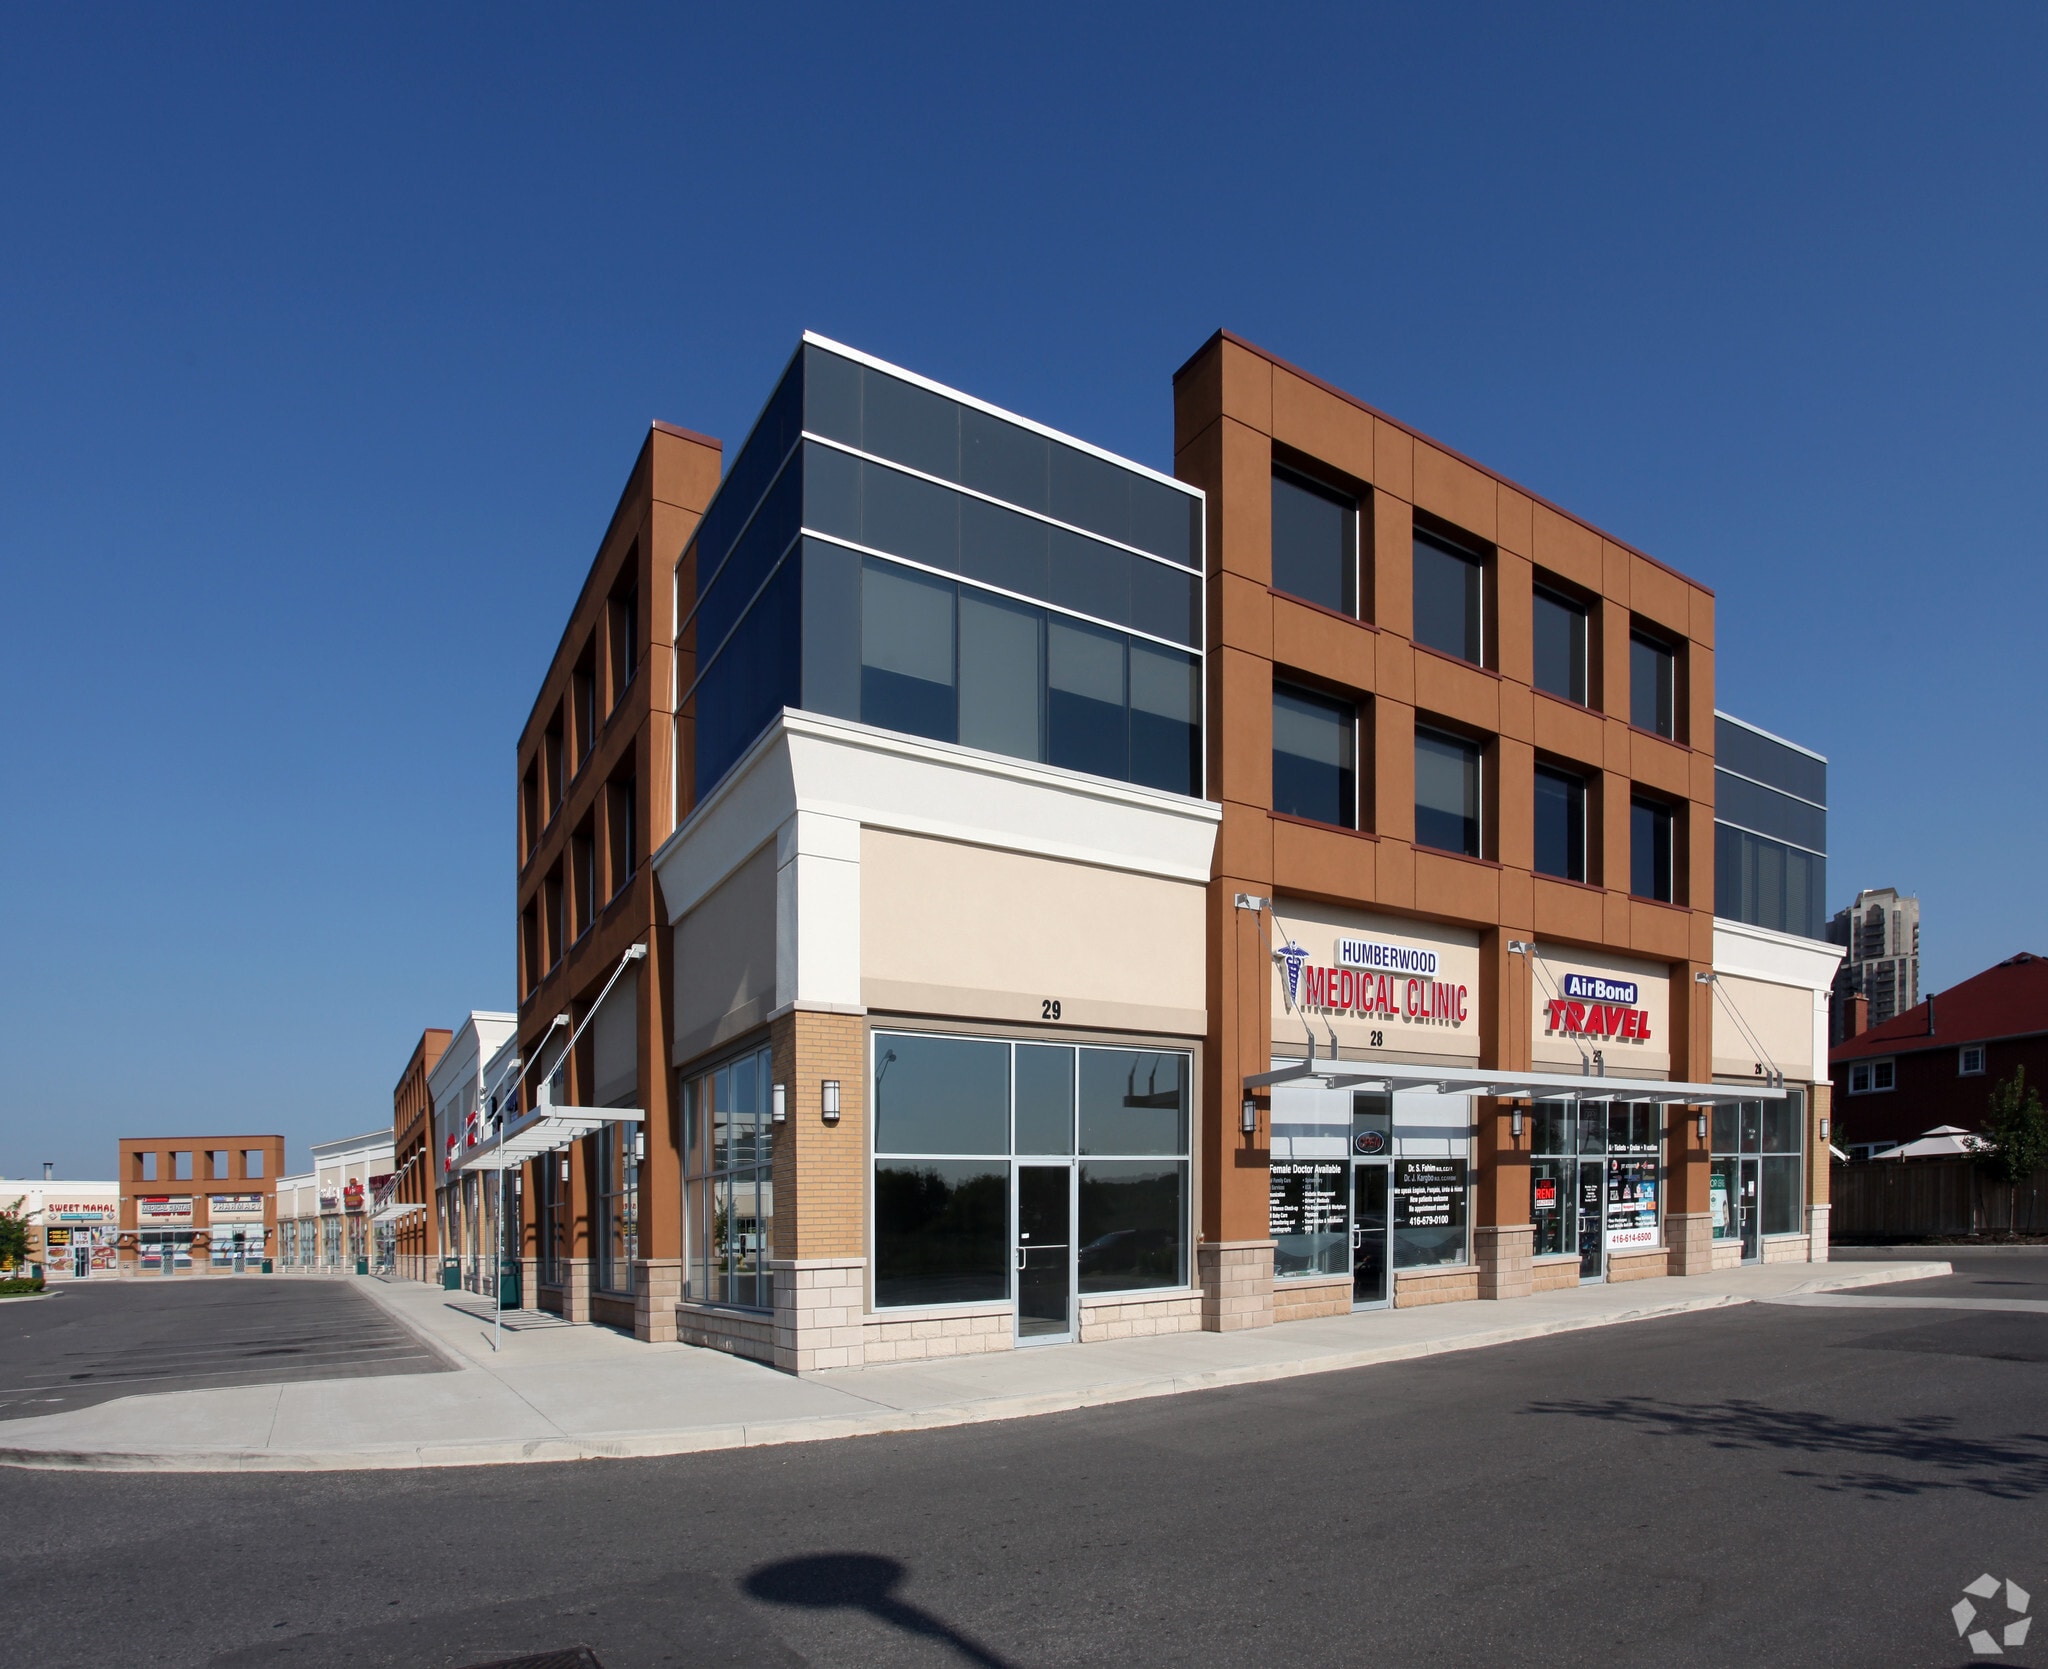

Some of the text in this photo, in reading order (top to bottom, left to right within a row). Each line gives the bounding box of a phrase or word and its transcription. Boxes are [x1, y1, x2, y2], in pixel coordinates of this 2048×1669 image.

[1343, 941, 1436, 973] HUMBERWOOD
[1306, 965, 1468, 1022] MEDICAL CLINIC
[1569, 977, 1634, 1002] AirBond
[1042, 999, 1061, 1020] 29
[1548, 999, 1651, 1039] TRAVEL
[1370, 1030, 1383, 1046] 28
[1755, 1063, 1762, 1075] 26
[1269, 1164, 1341, 1174] Female Doctor Available
[1416, 1164, 1421, 1172] S.
[1412, 1174, 1416, 1182] J.
[1536, 1188, 1555, 1200] RENT
[49, 1204, 115, 1212] SWEET MAHAL
[142, 1203, 168, 1211] MEDICAL
[213, 1202, 262, 1210] PHARMACY
[1410, 1215, 1449, 1226] 416-679-0100
[1612, 1233, 1652, 1243] 416-614-6500
